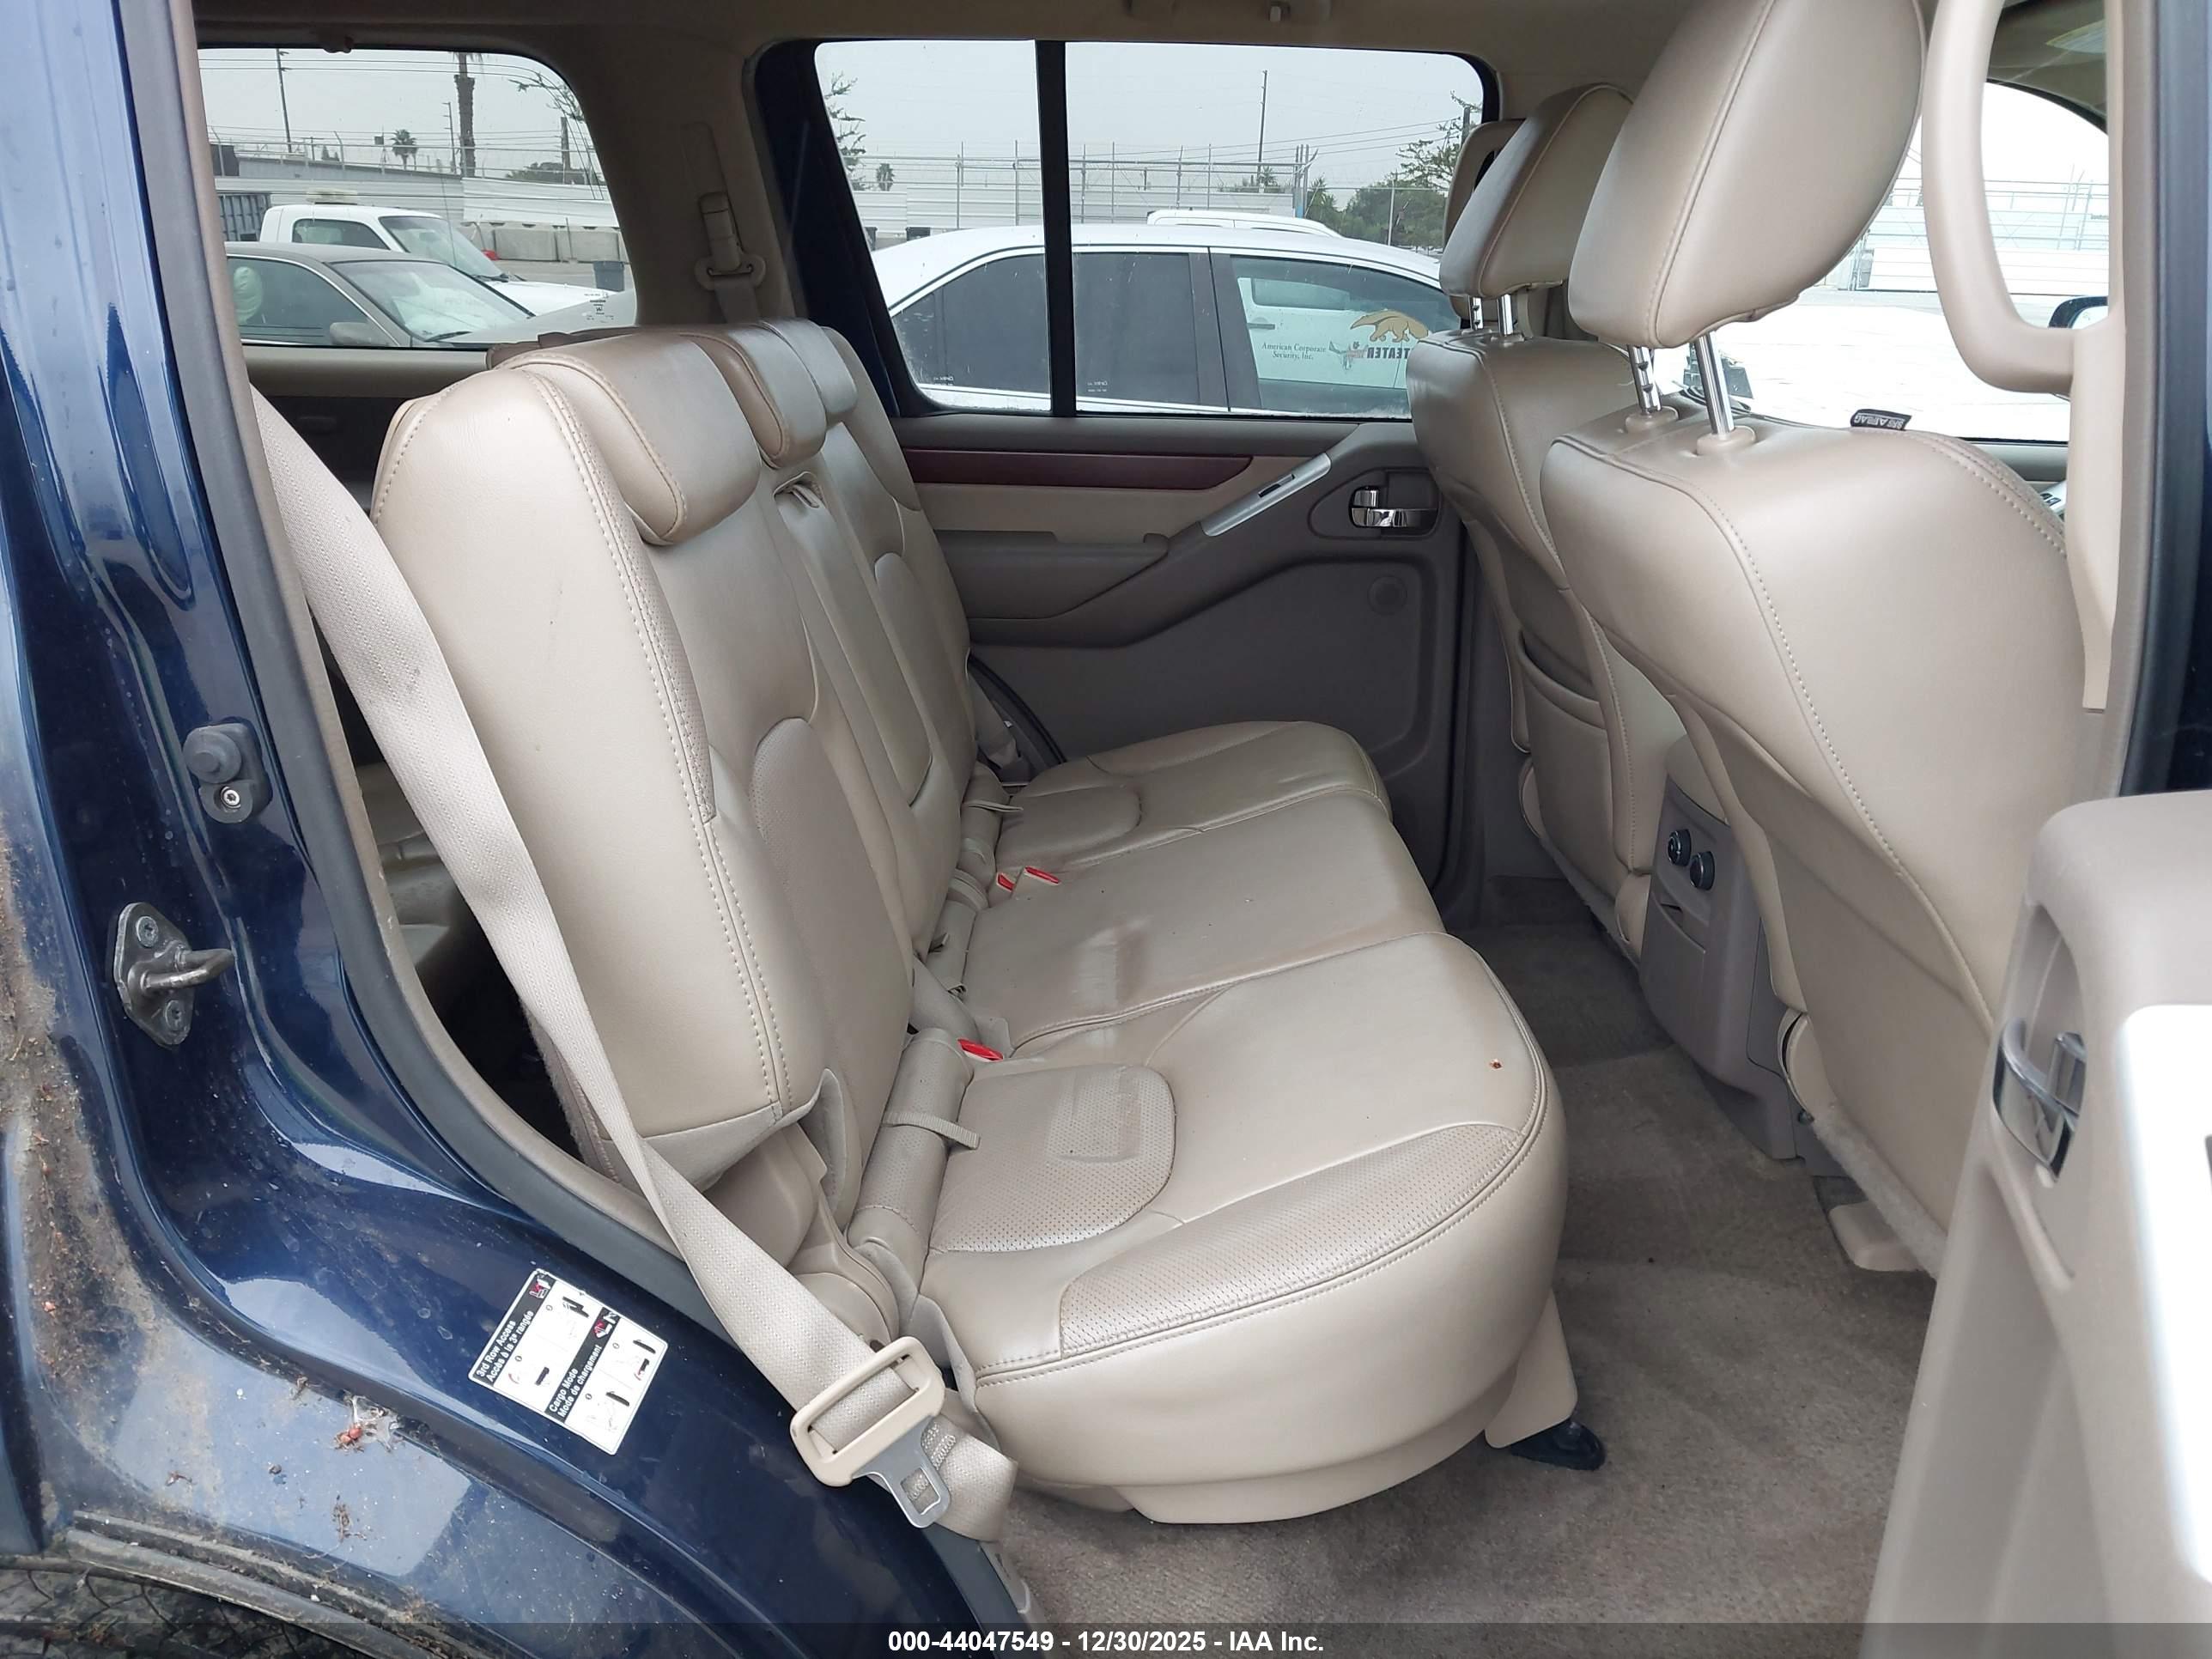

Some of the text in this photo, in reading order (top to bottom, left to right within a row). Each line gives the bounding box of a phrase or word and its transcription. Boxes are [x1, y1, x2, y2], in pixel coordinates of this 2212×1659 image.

[1261, 342, 1326, 354] American Corporate
[1302, 351, 1314, 360] Inc.
[476, 1320, 516, 1377] 3rd Row Access
[503, 1343, 514, 1352] la
[549, 1368, 579, 1413] Cargo Mode
[557, 1395, 574, 1418] Mode
[570, 1384, 580, 1396] de
[576, 1344, 602, 1385] chargement
